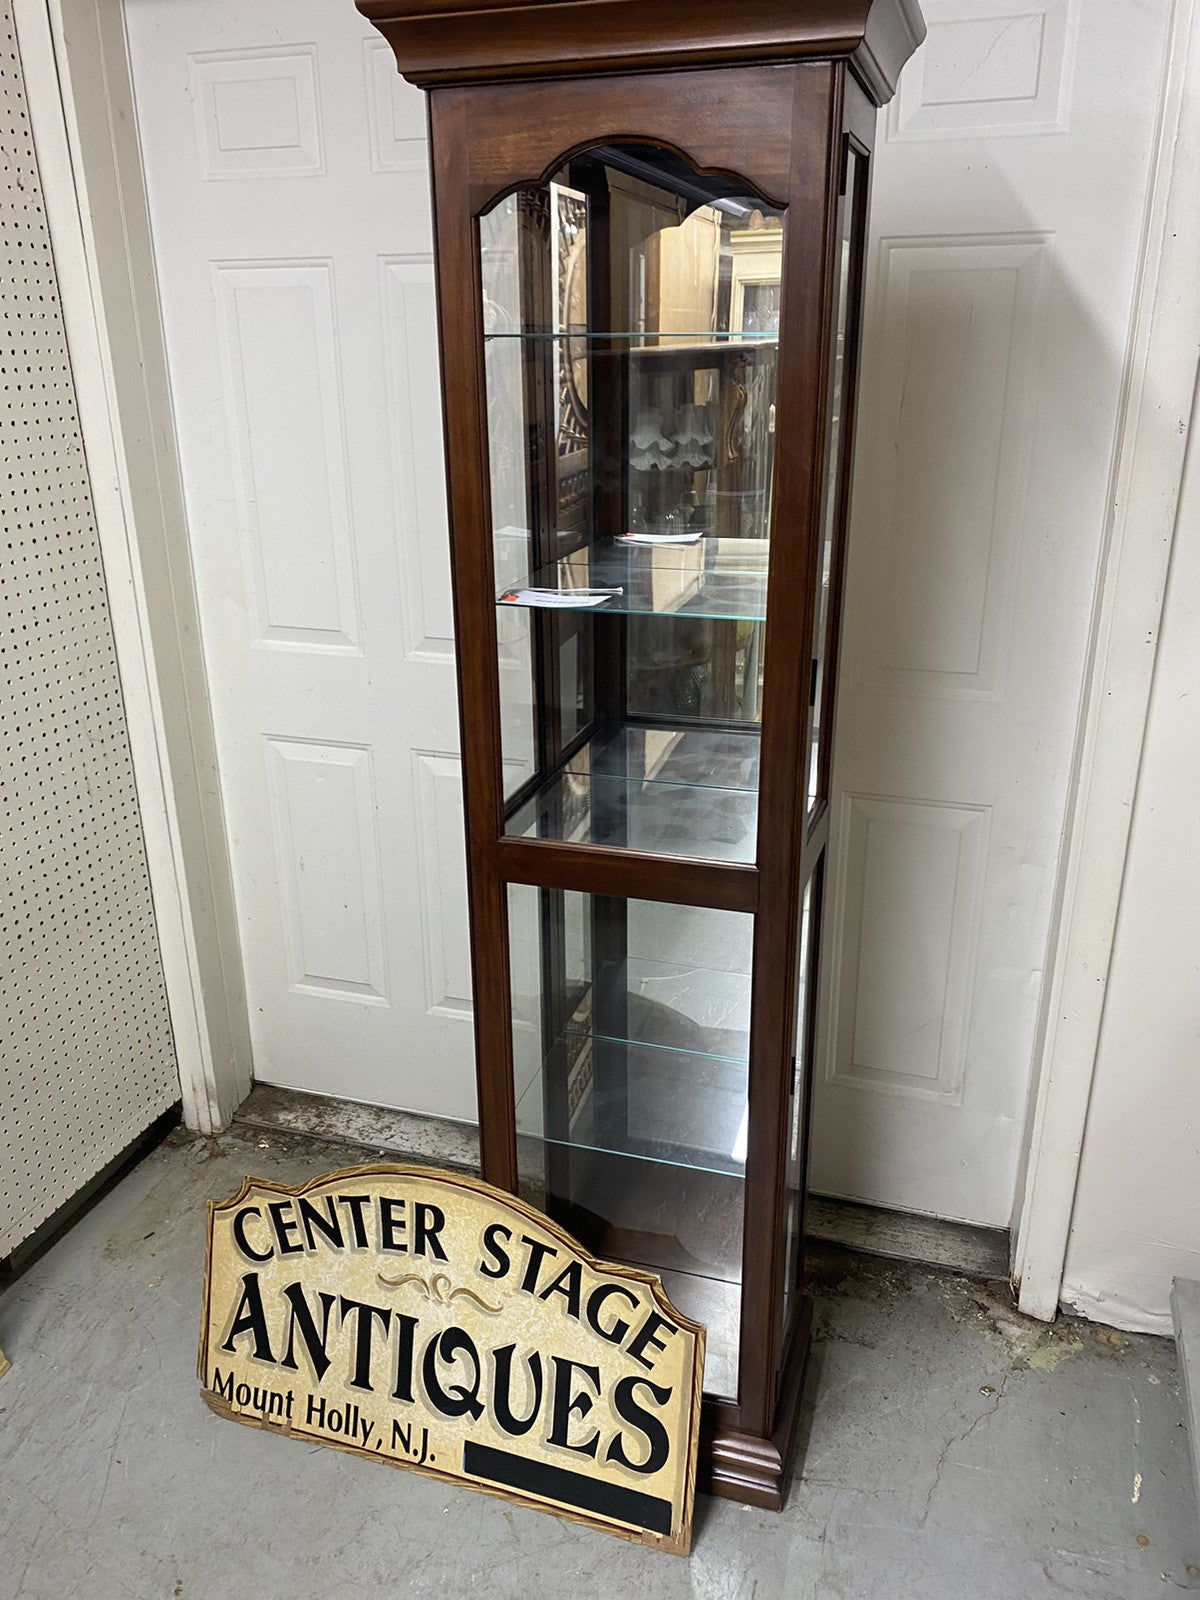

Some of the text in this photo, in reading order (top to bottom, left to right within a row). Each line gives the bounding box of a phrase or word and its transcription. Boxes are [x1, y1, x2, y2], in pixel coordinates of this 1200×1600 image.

[232, 1194, 681, 1372] CENTER STAGE
[211, 1366, 436, 1464] Mount Holly, N.J.
[221, 1271, 674, 1475] ANTIQUES
